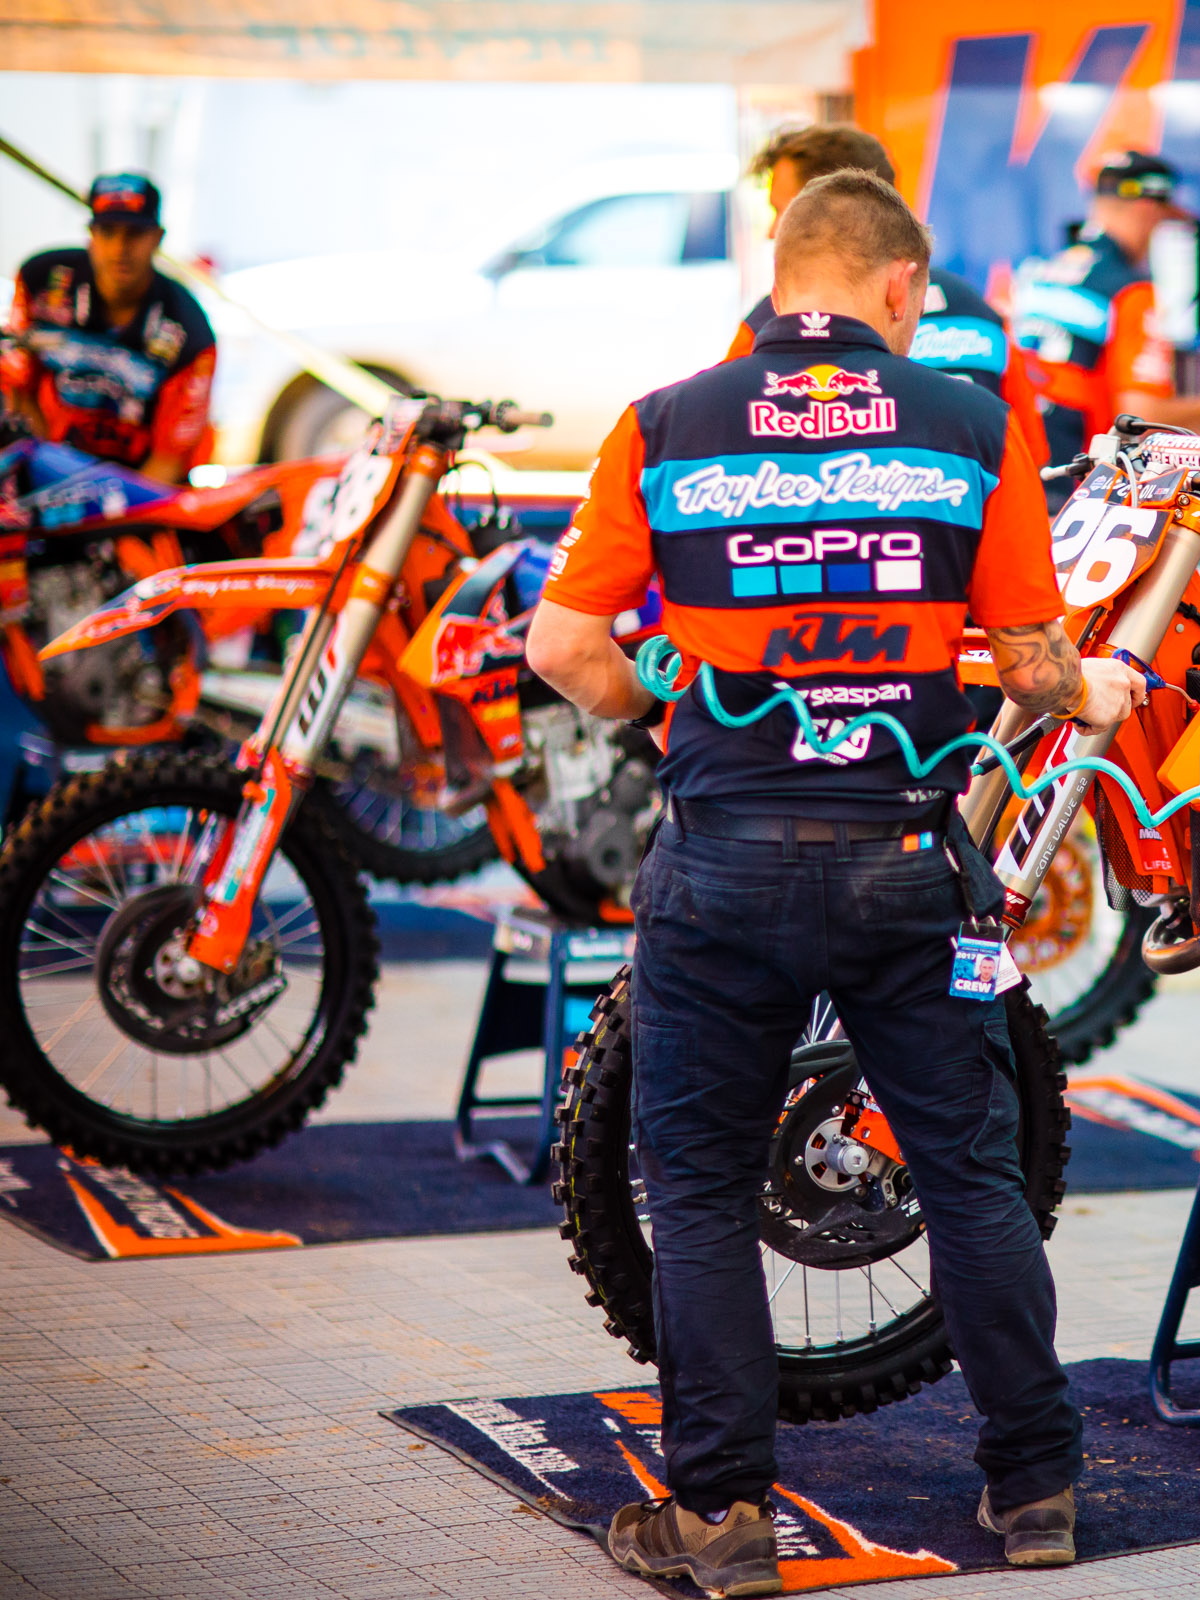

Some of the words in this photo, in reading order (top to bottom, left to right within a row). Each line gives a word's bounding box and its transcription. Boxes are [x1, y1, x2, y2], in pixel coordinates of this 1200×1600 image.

[801, 329, 829, 338] adidas
[748, 401, 823, 439] Red
[823, 398, 896, 438] Bull
[674, 464, 752, 518] Troy
[752, 461, 820, 507] Lee
[820, 452, 969, 511] Designs
[729, 530, 922, 564] GoPro
[761, 612, 912, 667] KTM
[810, 683, 912, 707] seaspan
[1036, 843, 1056, 878] CONE
[1053, 797, 1077, 840] VALVE
[956, 951, 976, 960] 2017
[954, 979, 992, 993] CREW
